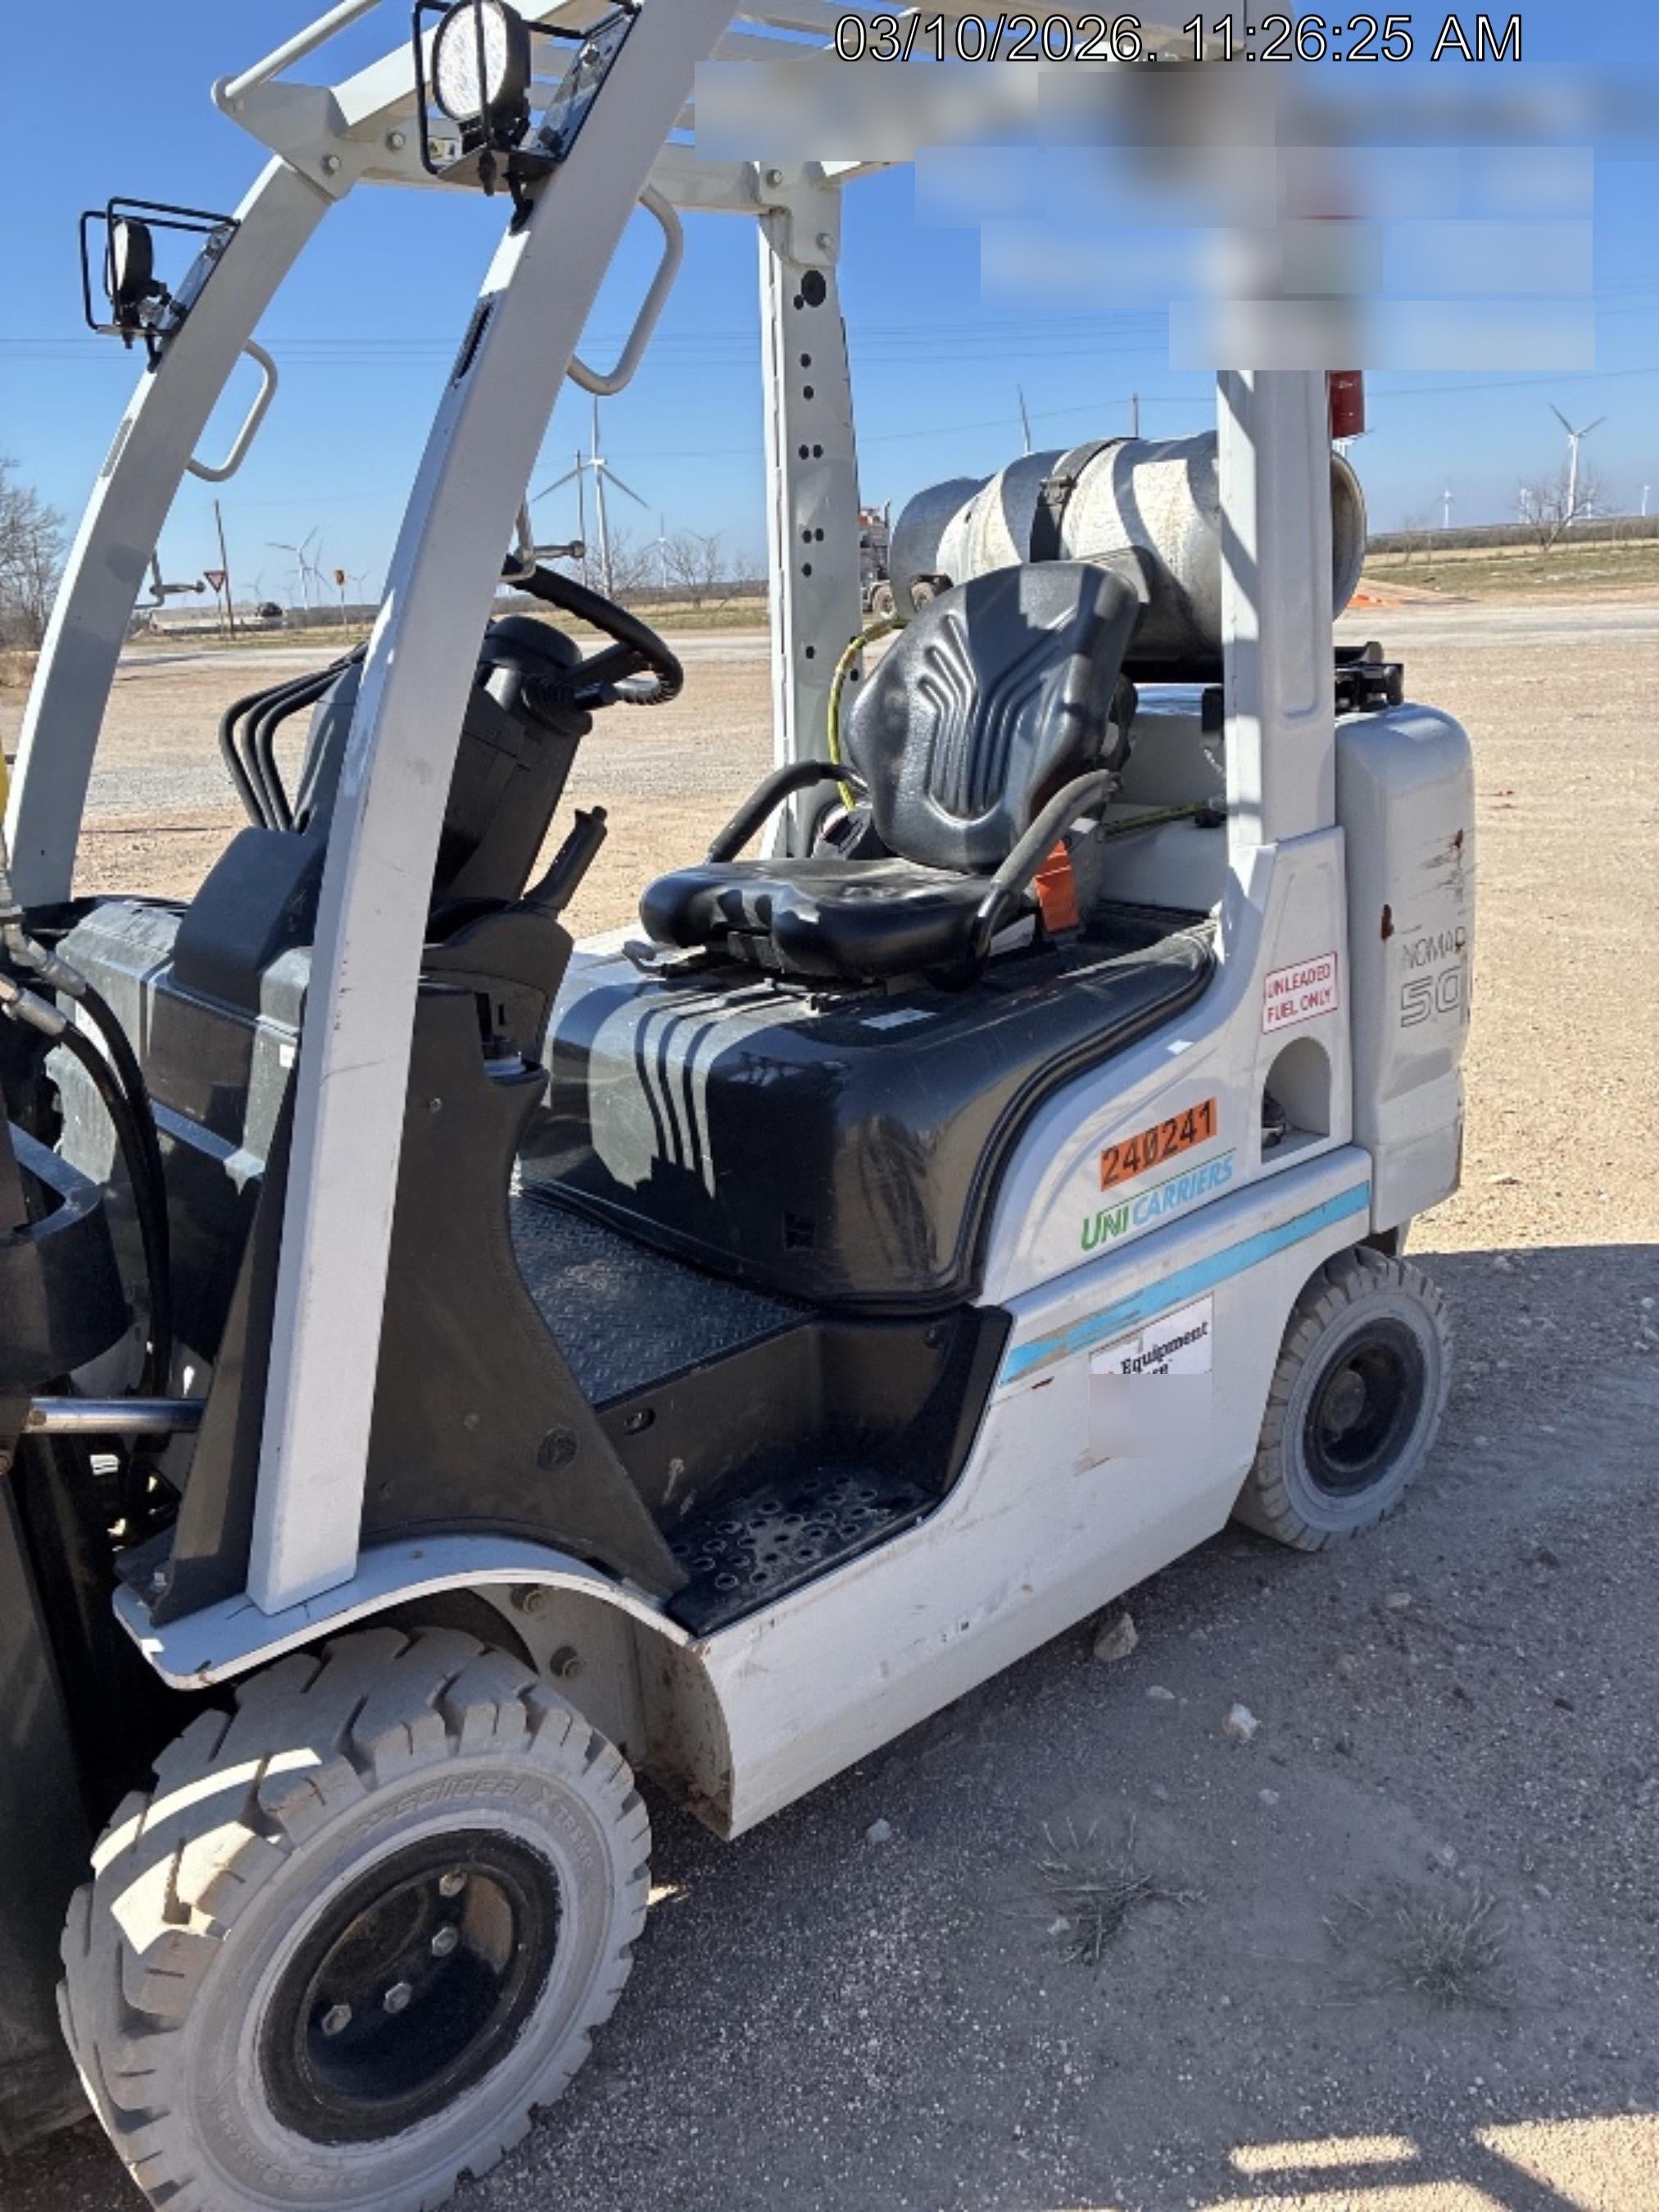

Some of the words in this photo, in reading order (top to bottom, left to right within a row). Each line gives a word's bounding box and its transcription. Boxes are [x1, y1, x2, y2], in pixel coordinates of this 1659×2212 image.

[1266, 963, 1330, 999] UNLEADED
[1267, 999, 1299, 1022] FUEL
[1299, 988, 1331, 1011] ONLY
[1401, 965, 1465, 1028] 50
[1102, 1099, 1211, 1189] 240241
[1121, 1321, 1209, 1374] Equipment
